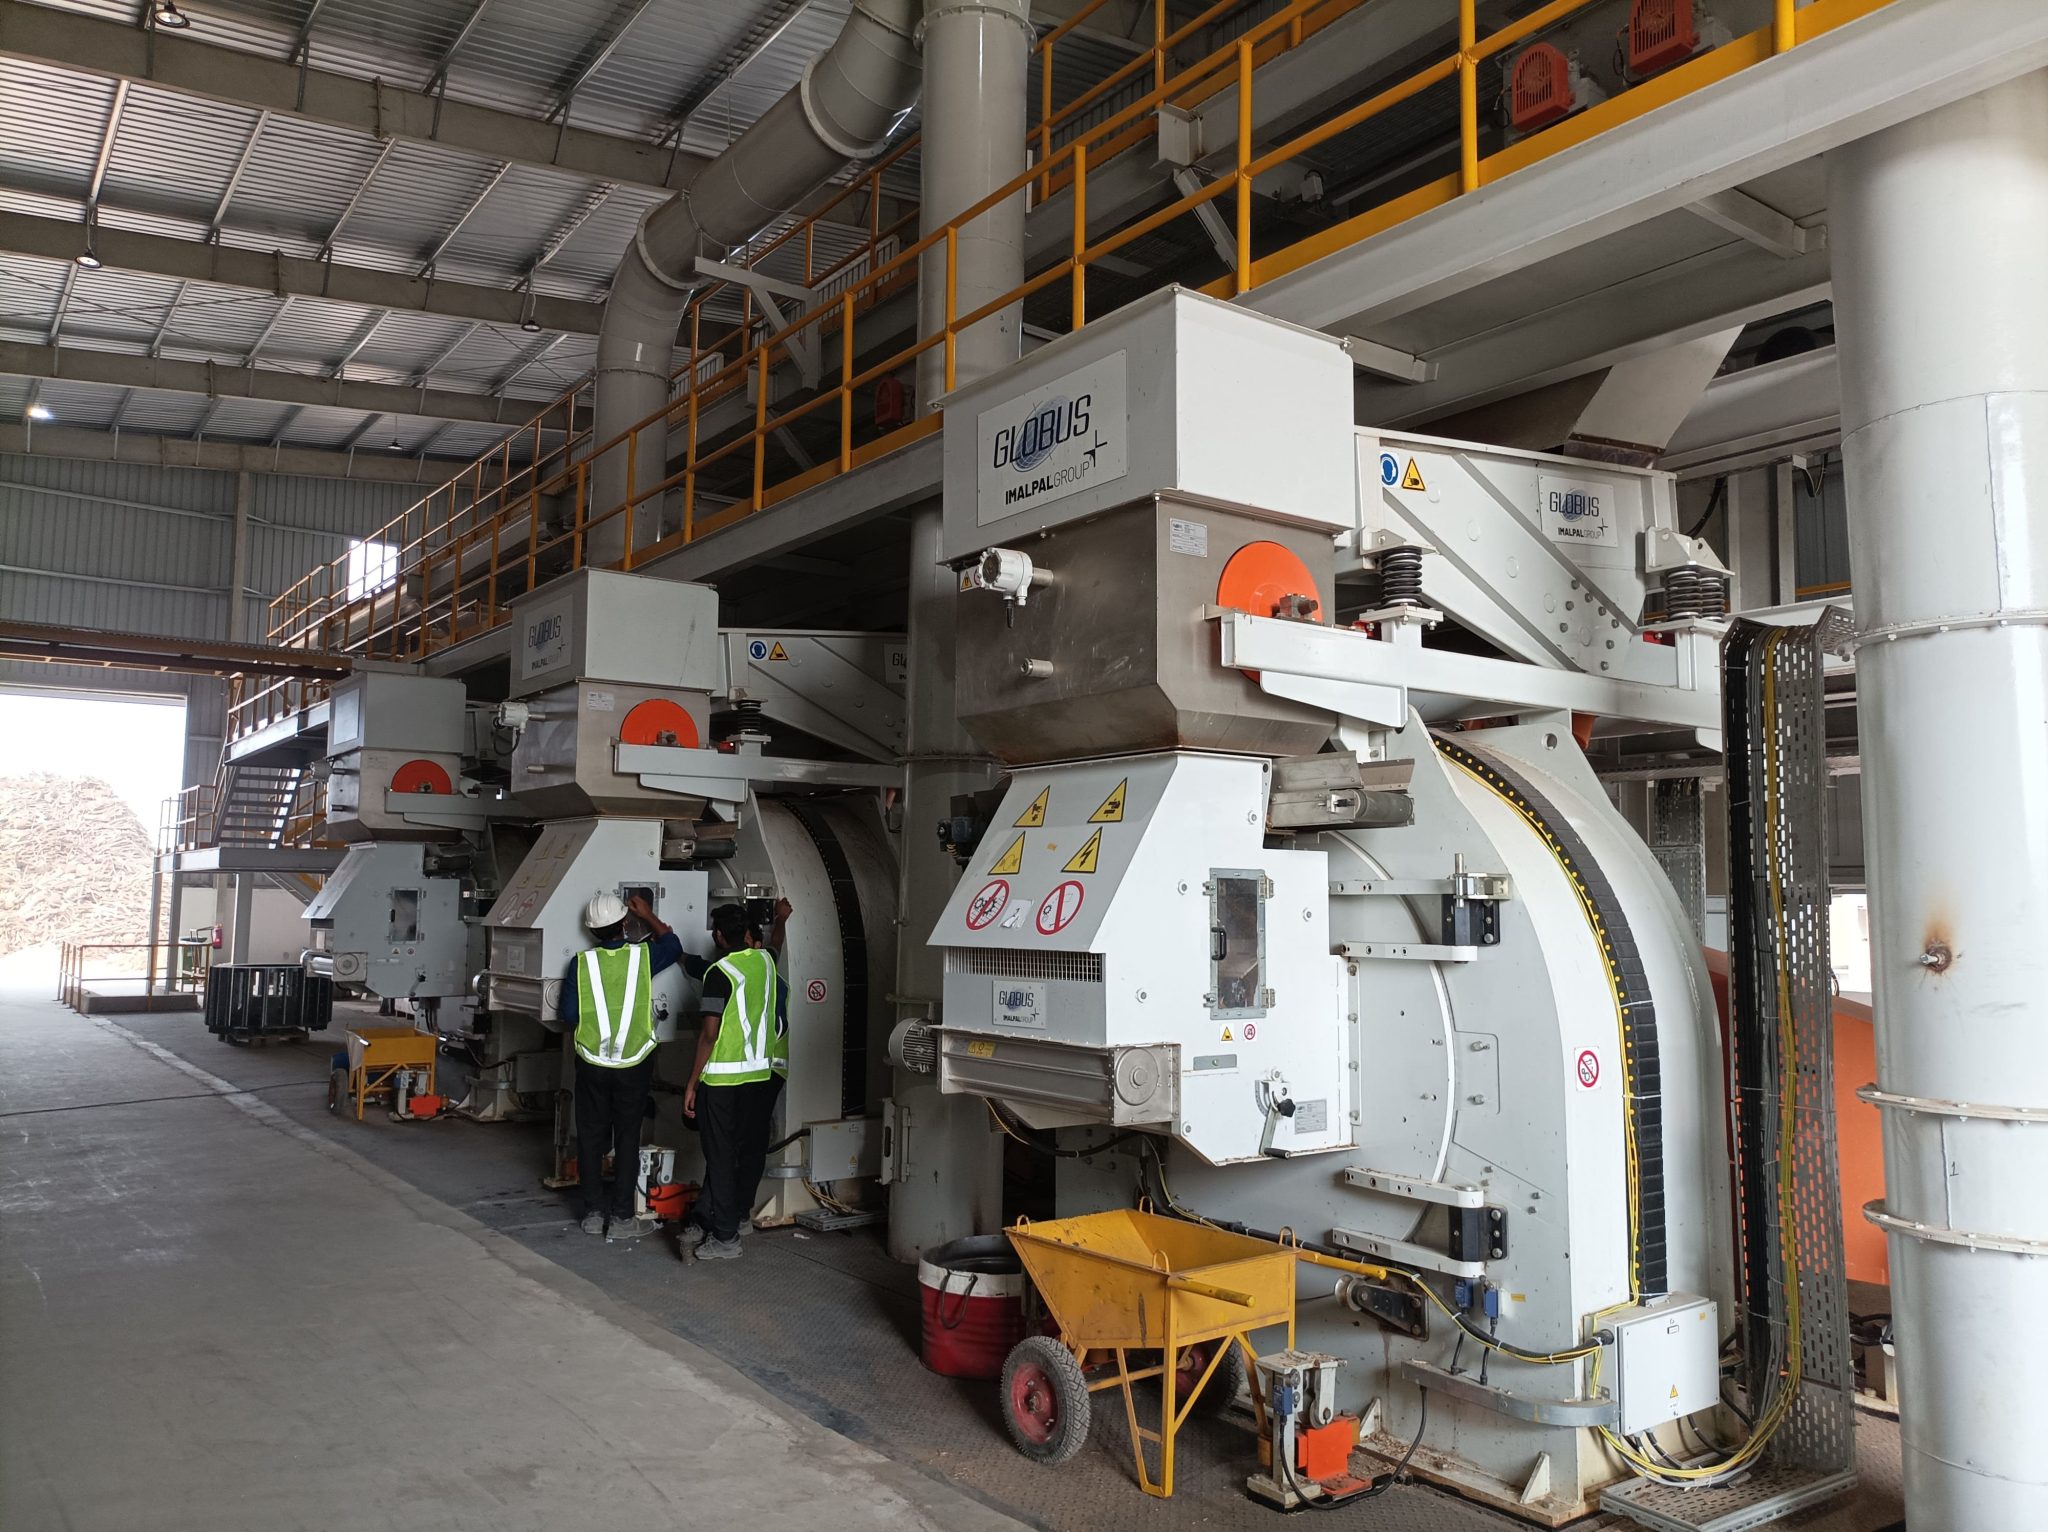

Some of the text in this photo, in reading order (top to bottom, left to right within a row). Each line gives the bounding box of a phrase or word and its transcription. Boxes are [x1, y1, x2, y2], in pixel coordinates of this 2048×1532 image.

[993, 394, 1091, 469] GLOBUS
[1005, 461, 1090, 505] IMALPALGROUP
[1550, 491, 1599, 517] GLOBUS
[528, 615, 561, 648] GLOBUS
[998, 990, 1034, 1007] GLOBUS
